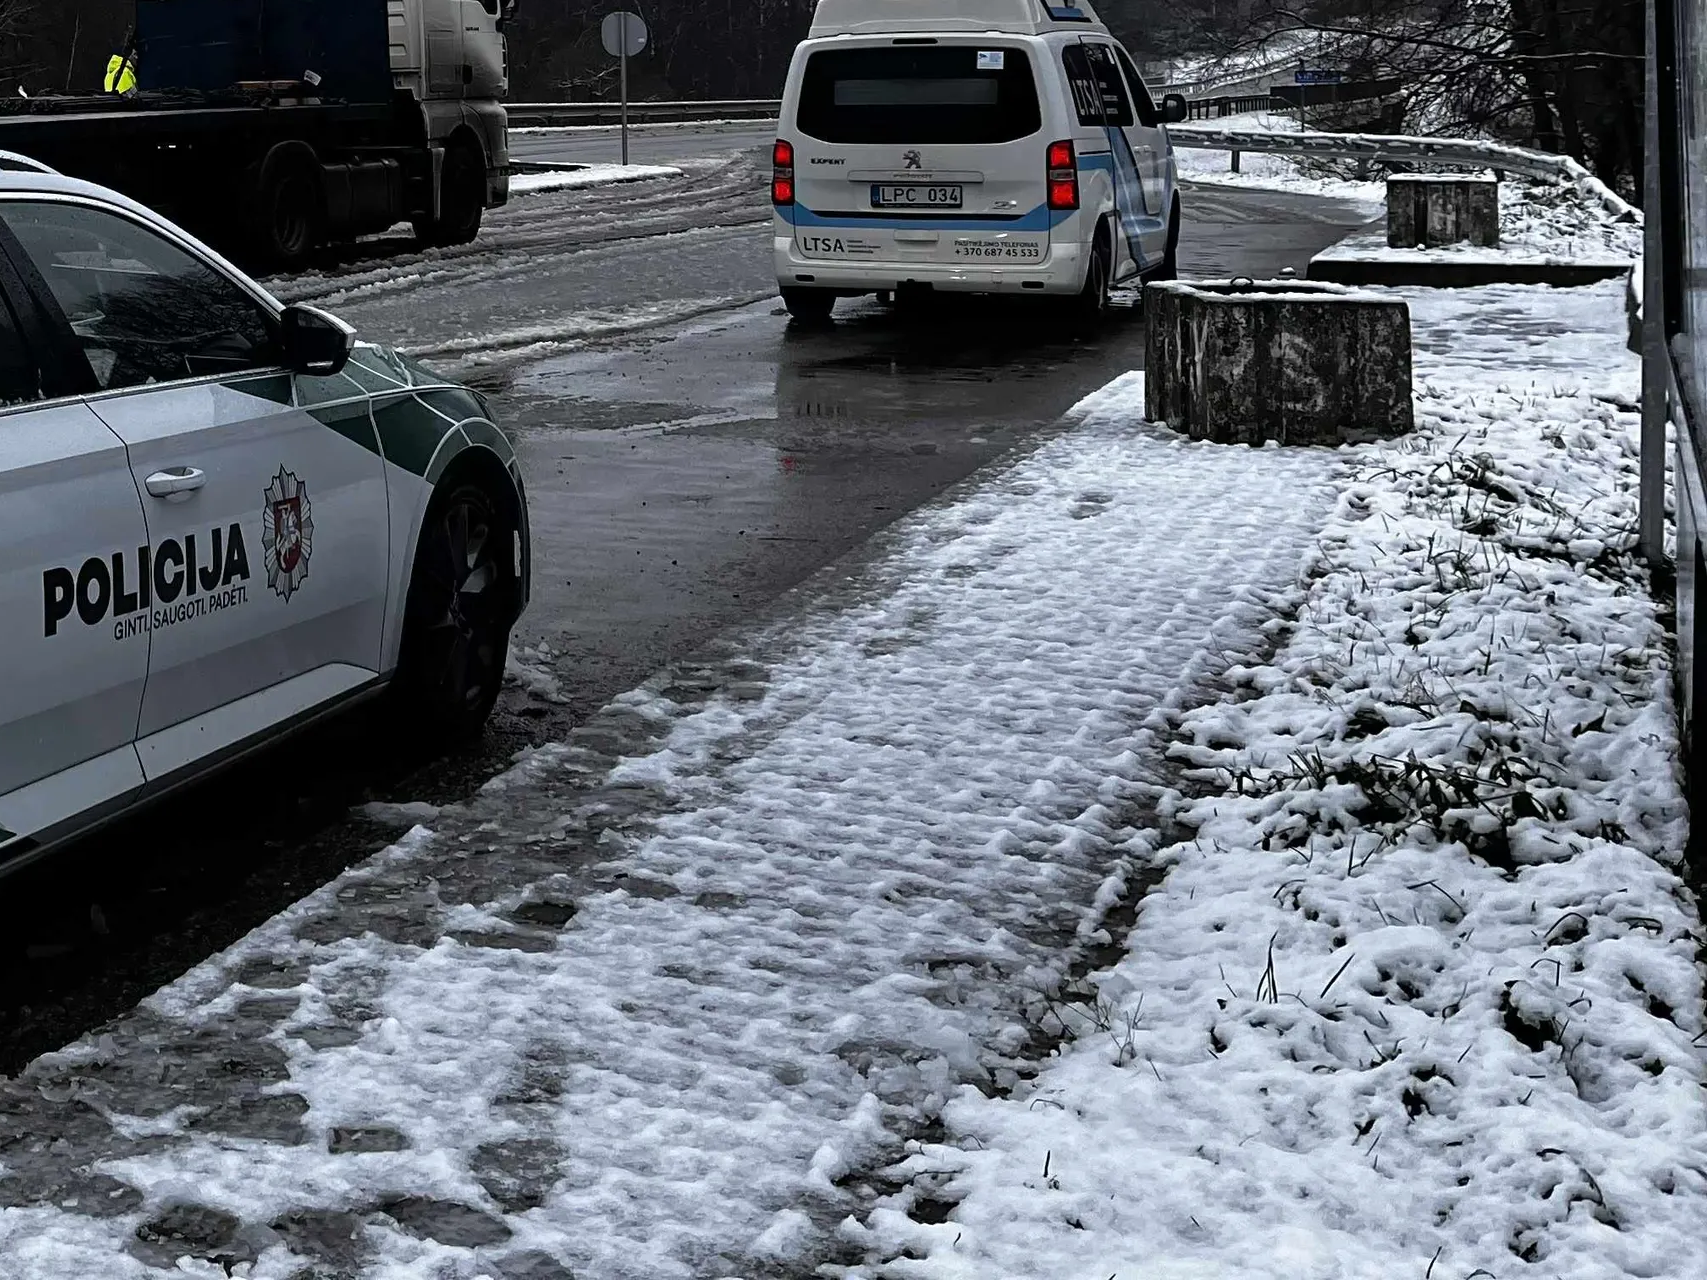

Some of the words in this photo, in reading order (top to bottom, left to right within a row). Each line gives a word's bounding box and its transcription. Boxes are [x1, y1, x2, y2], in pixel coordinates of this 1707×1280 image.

[1072, 80, 1103, 115] LTSA
[882, 187, 916, 202] LPC
[928, 187, 958, 202] 034
[803, 237, 845, 253] LTSA
[963, 247, 982, 256] 370
[984, 248, 1003, 257] 687
[1005, 248, 1018, 257] 45
[1021, 248, 1039, 257] 533
[43, 523, 251, 638] POLICIJA
[114, 614, 151, 641] GINTI.
[153, 597, 207, 630] SAUGOTI.
[209, 584, 248, 615] PADĖTI.
